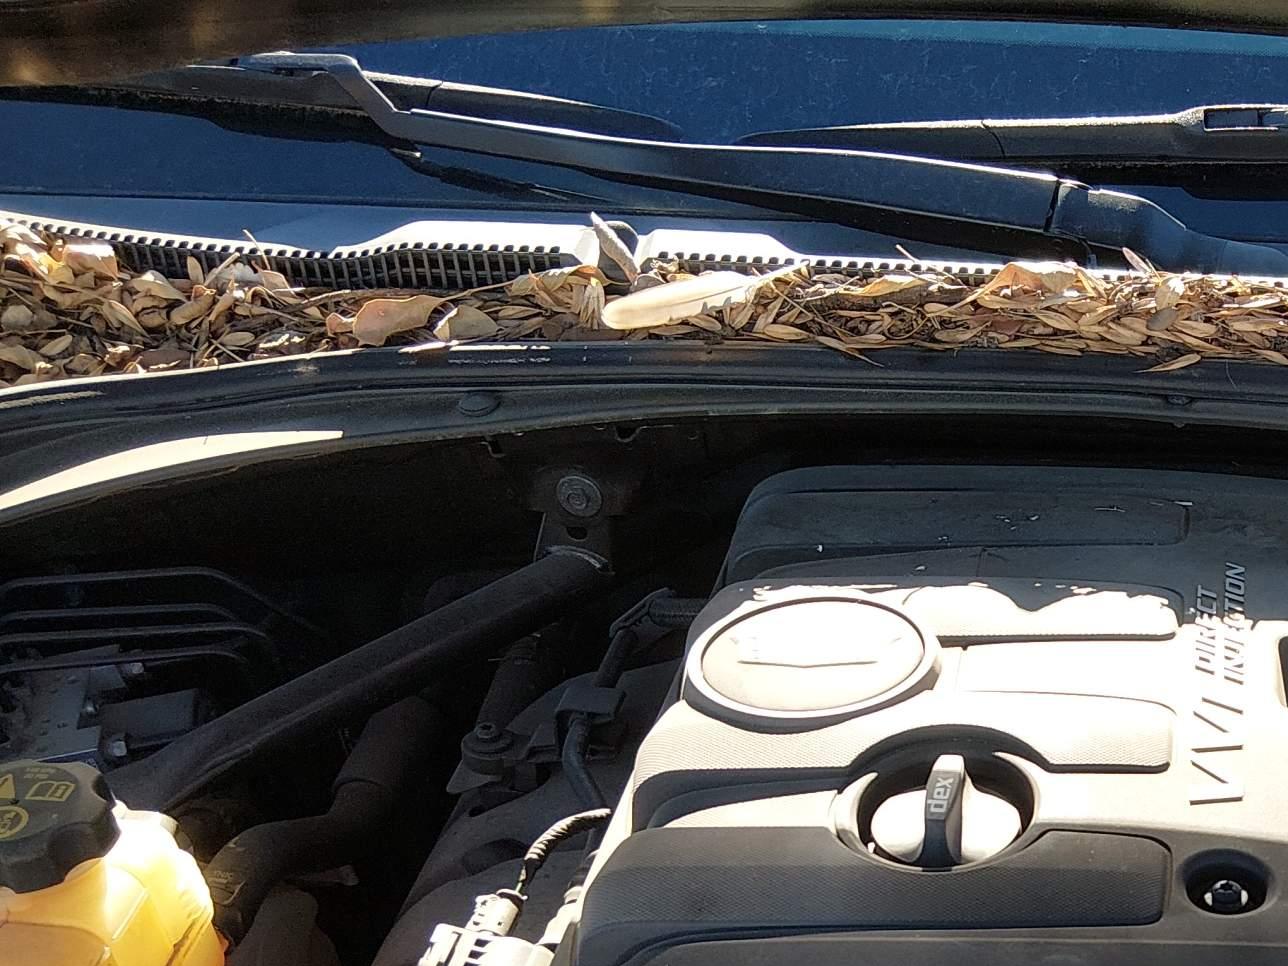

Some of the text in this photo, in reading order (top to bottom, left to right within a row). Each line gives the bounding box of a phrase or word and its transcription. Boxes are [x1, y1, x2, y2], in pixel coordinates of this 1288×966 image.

[1195, 584, 1217, 675] DIRECT
[1223, 562, 1246, 686] INJECTION
[927, 777, 954, 813] dex
